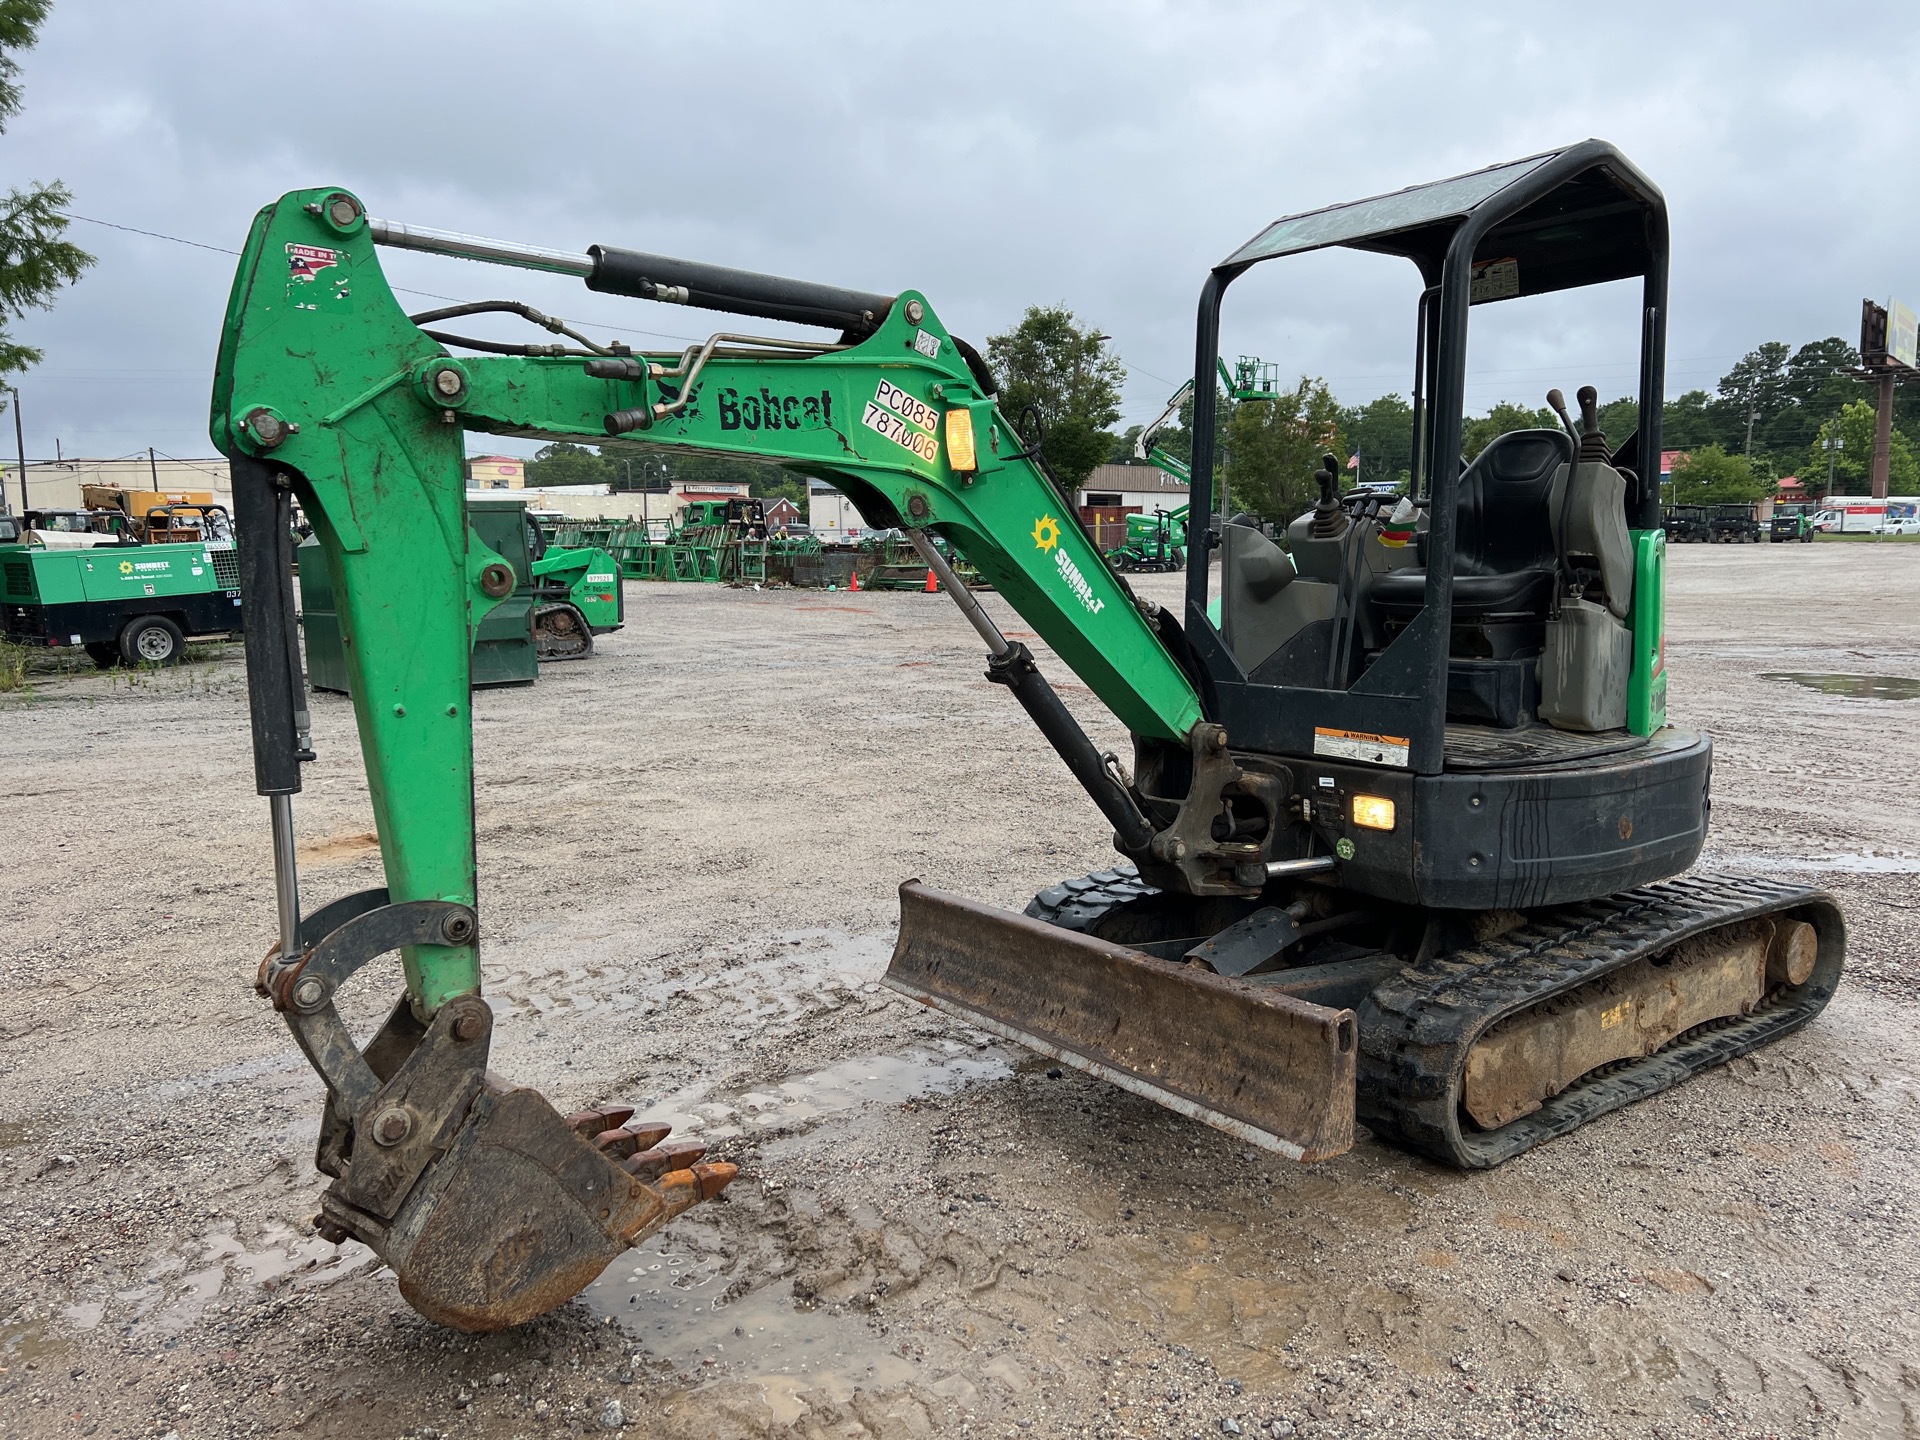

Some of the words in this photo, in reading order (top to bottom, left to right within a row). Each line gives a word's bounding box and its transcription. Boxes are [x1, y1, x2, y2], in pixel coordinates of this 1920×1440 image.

[291, 247, 316, 257] MADE
[317, 251, 328, 259] IN
[717, 387, 832, 432] Bobcat
[134, 561, 170, 570] SUNBELT
[1054, 547, 1105, 615] SUNBELT
[1056, 567, 1092, 613] RENTALS
